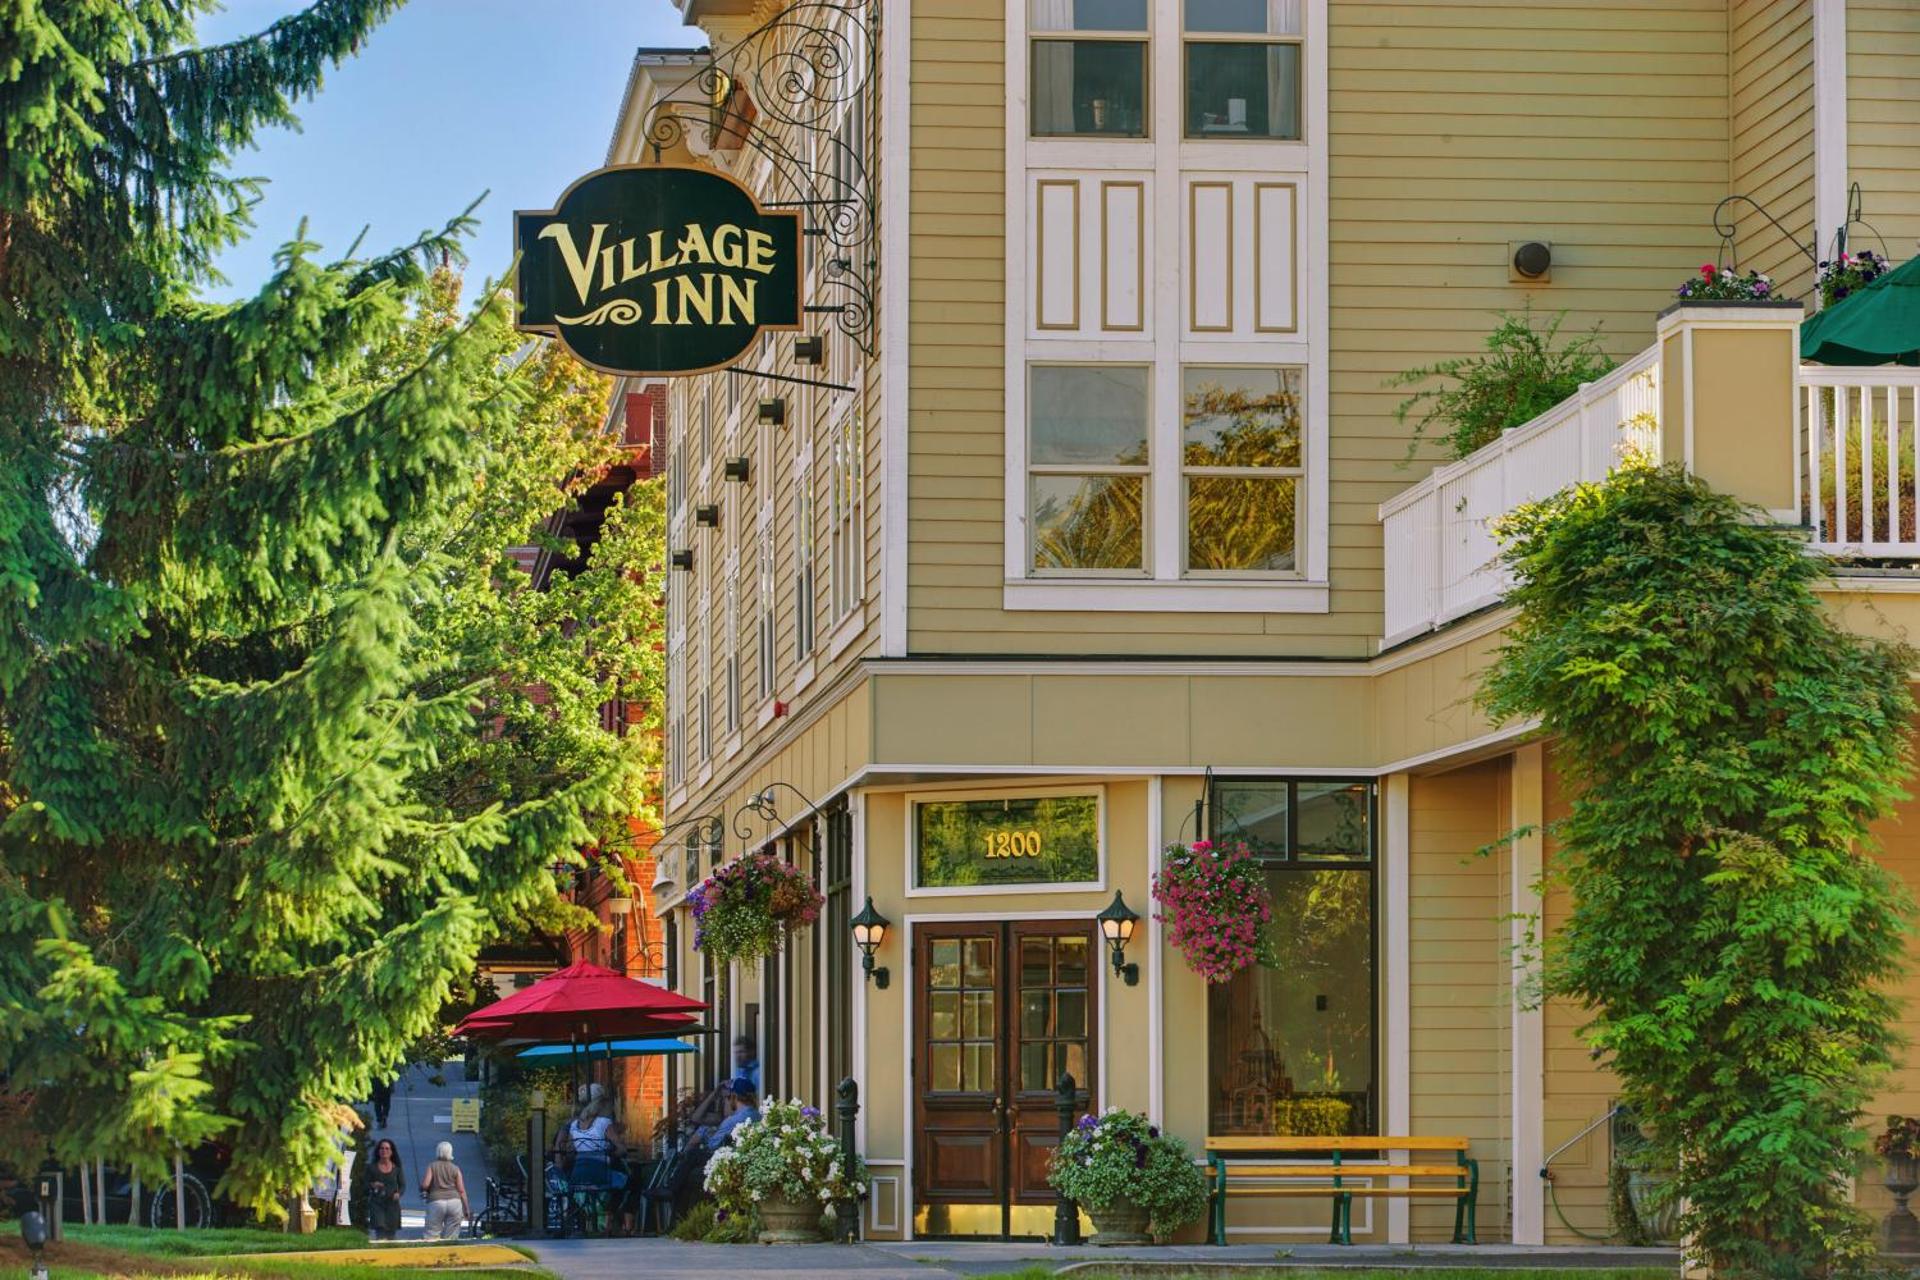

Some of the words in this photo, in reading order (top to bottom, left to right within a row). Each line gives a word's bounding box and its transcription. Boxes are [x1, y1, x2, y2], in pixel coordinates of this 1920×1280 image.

[538, 223, 777, 306] VILLAGE
[650, 273, 758, 325] INN
[984, 830, 1041, 859] 1200
